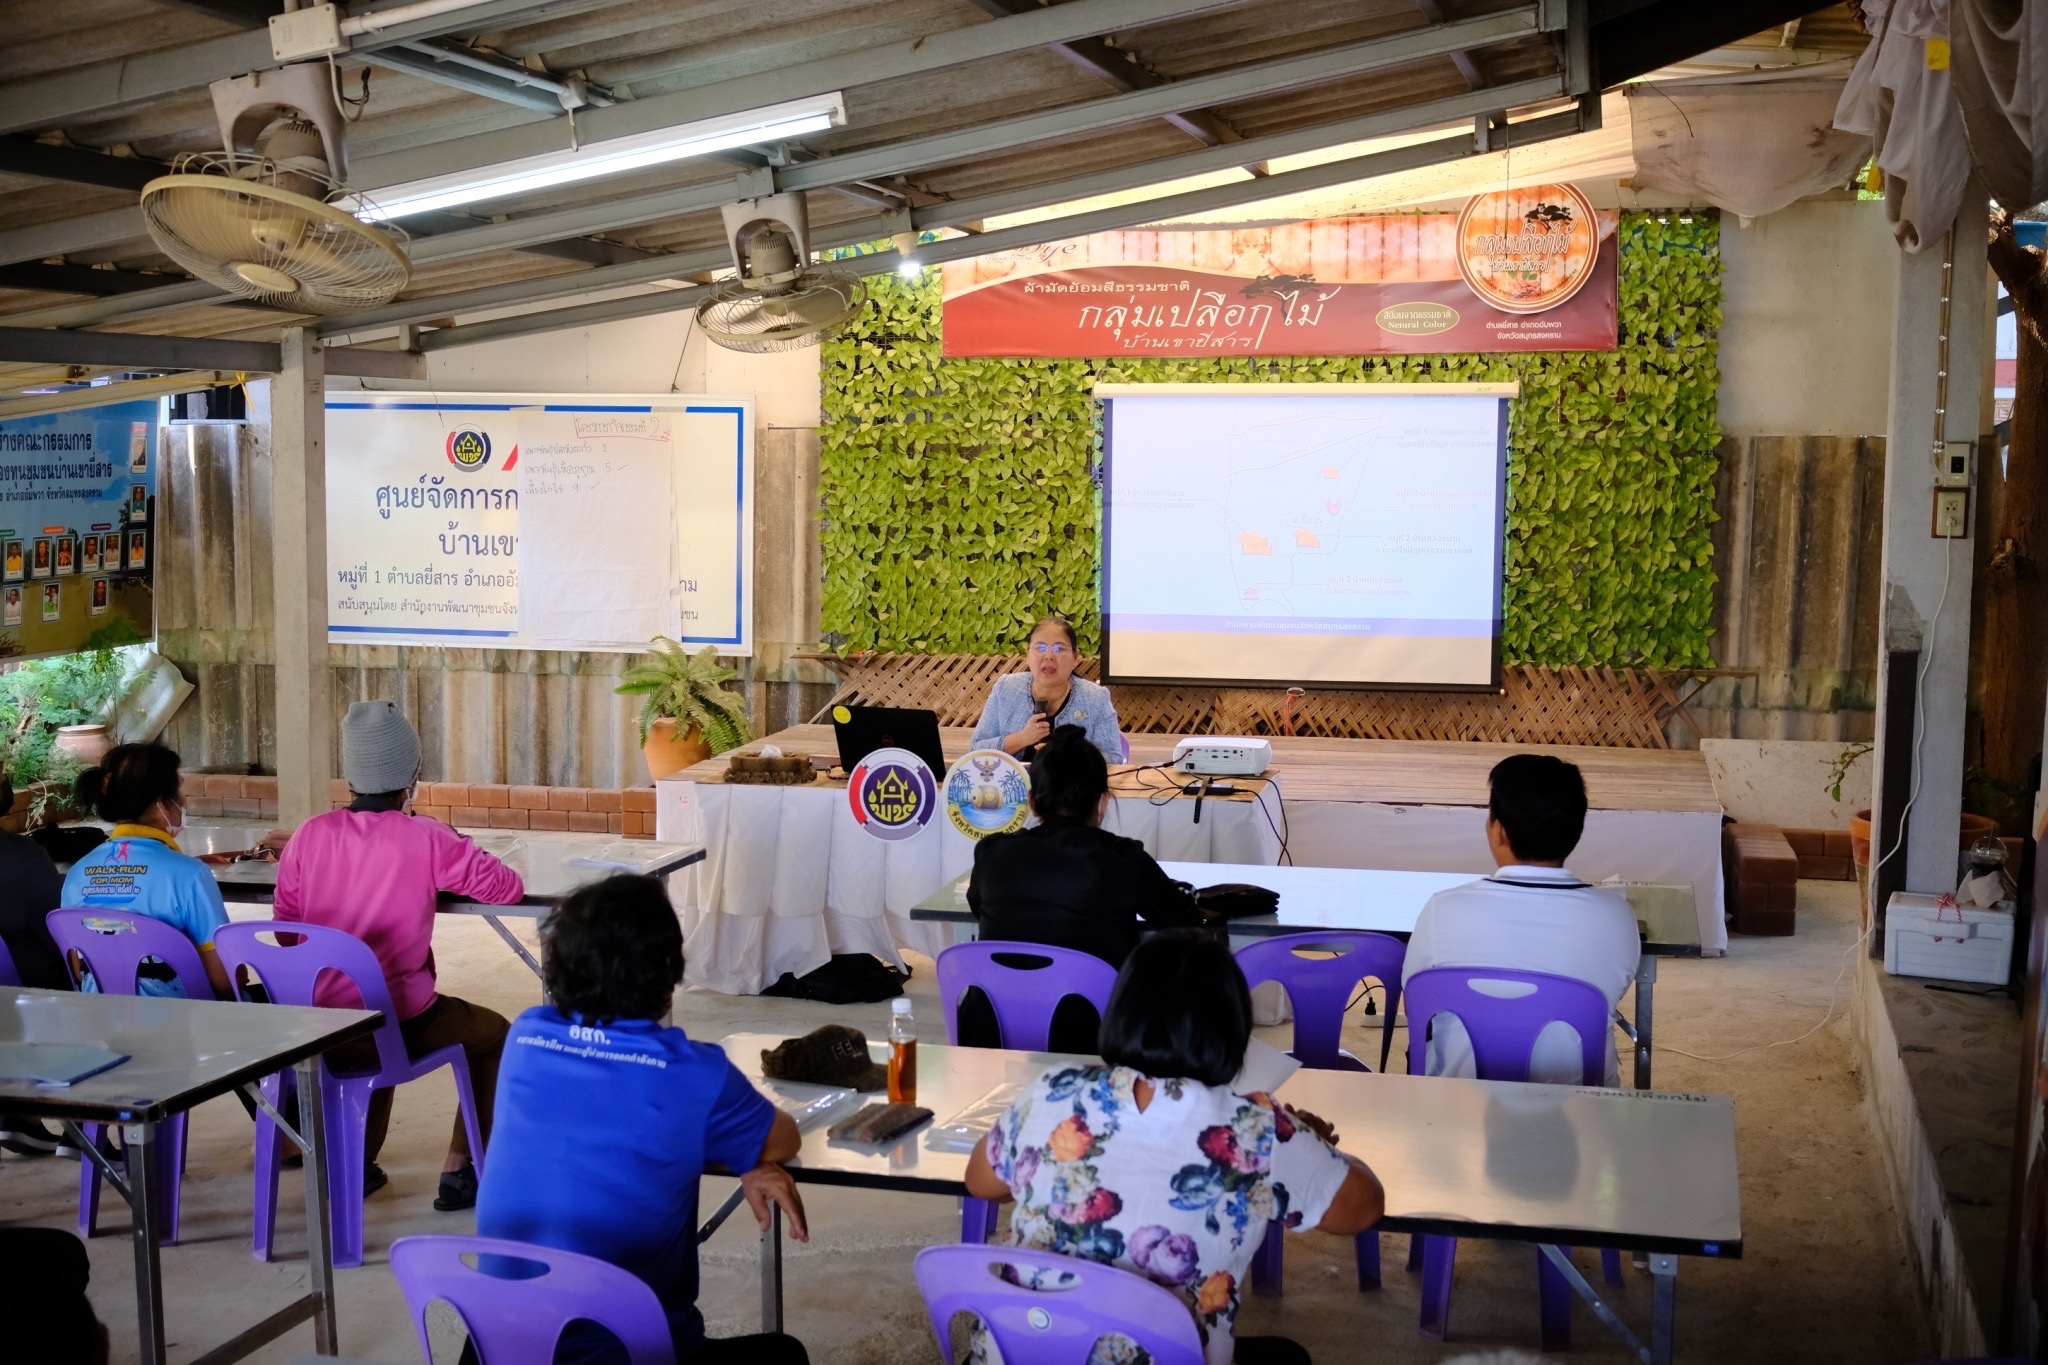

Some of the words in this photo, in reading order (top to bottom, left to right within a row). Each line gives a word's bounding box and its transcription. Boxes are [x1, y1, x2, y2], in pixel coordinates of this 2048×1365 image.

[1024, 280, 1191, 293] ผ้ามัดย้อมสีธรรมชาติ
[1078, 285, 1342, 350] กลุ่มเปลือกไม้
[1388, 321, 1419, 329] Netural
[1423, 320, 1447, 328] Color
[1486, 320, 1519, 330] ตำบลยี่สาร
[1521, 320, 1562, 330] อำเภออัมพวา
[1497, 331, 1562, 341] จังหวัดสมุทรสงคราม
[650, 416, 660, 438] 2
[605, 462, 611, 473] 5
[47, 486, 103, 504] จังหวัดสมุทรสงคราม
[438, 521, 518, 556] บ้านเข
[337, 561, 368, 590] หมู่ที่
[374, 570, 381, 583] 1
[387, 563, 458, 586] ตำบลยี่สาร
[337, 597, 397, 615] สนับสนุนโดย
[90, 877, 109, 885] FOR
[110, 877, 134, 885] MOM
